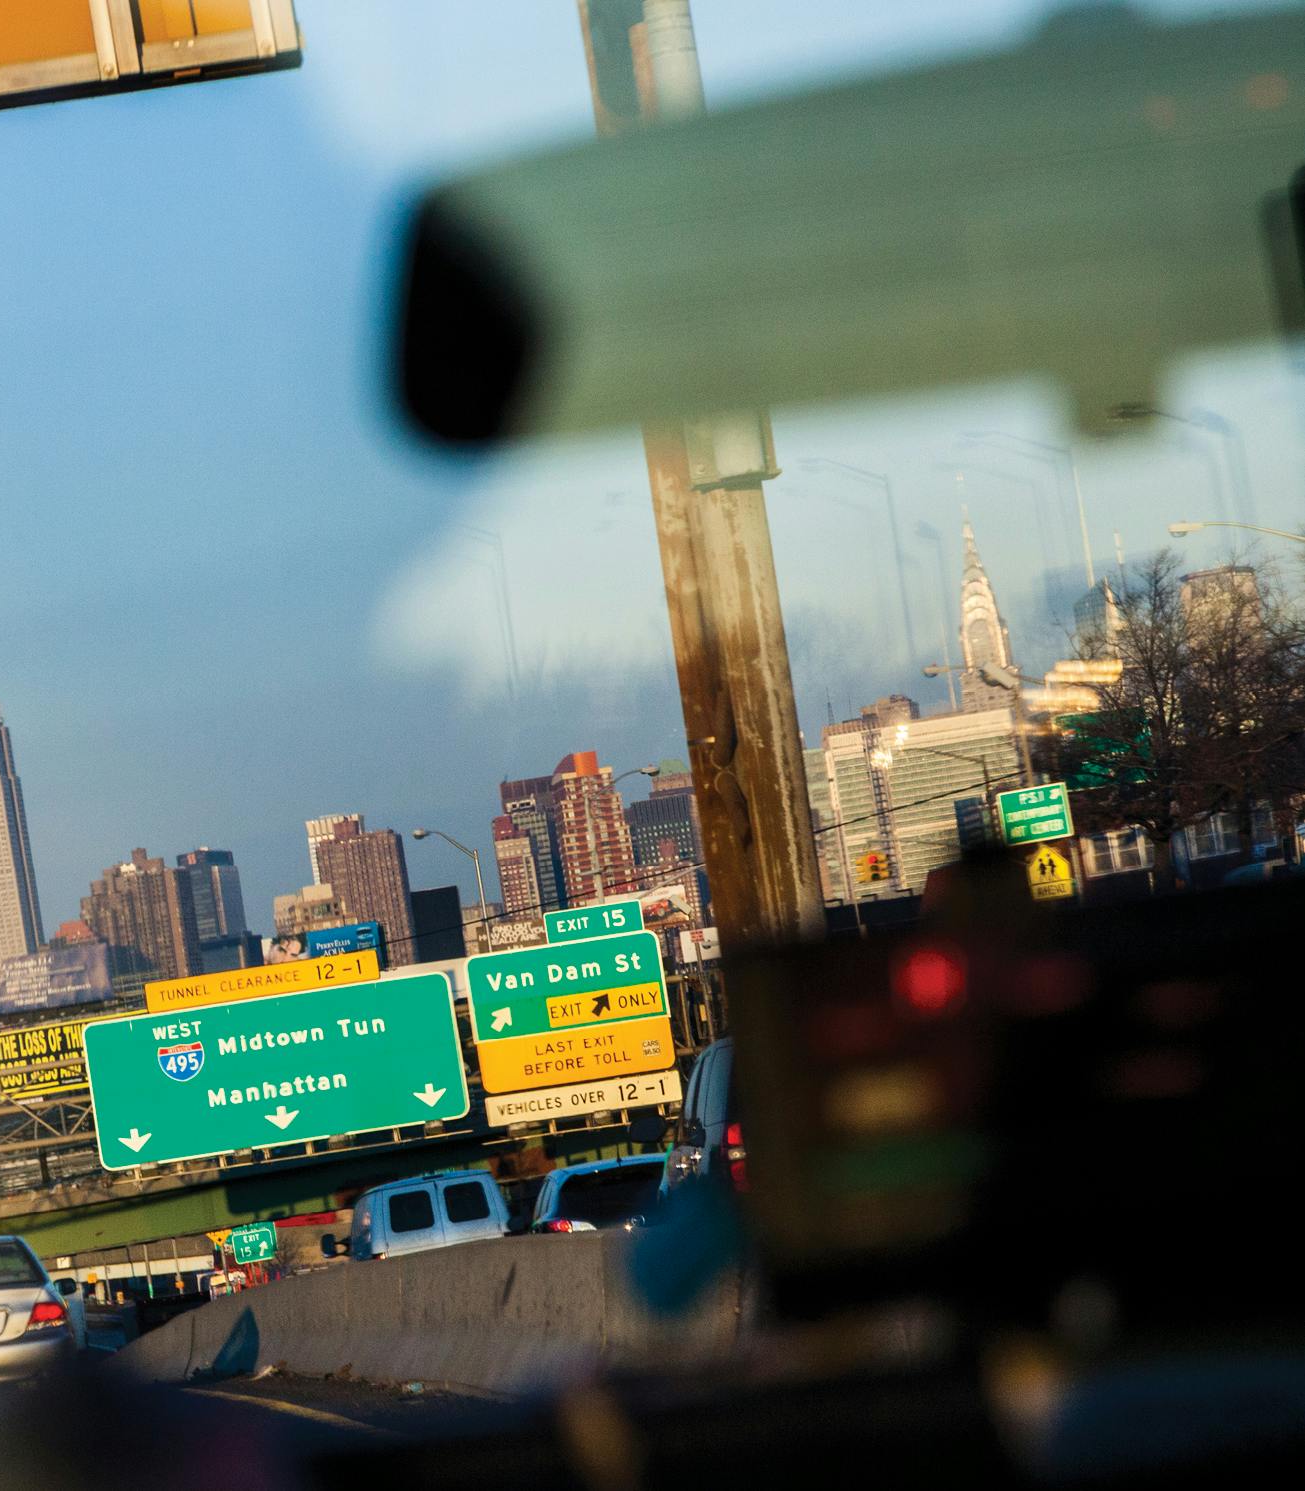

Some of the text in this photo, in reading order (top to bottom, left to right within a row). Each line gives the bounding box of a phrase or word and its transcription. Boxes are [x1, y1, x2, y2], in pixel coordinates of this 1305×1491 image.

[556, 909, 626, 933] EXIT 15
[487, 952, 642, 992] Van Dam St
[160, 984, 210, 1001] TUNNEL
[219, 970, 300, 992] CLEARANCE
[550, 991, 658, 1019] EXIT ONLY
[19, 1030, 47, 1057] LOSS
[48, 1028, 62, 1053] OF
[152, 1021, 202, 1040] WEST
[218, 1017, 386, 1056] Midtown Tun
[534, 1035, 616, 1056] LAST EXIT
[166, 1053, 199, 1073] 495
[524, 1051, 632, 1076] BEFORE TOLL
[207, 1073, 348, 1107] Manhattan
[497, 1097, 563, 1116] VEHICLES
[571, 1090, 606, 1106] OVER
[243, 1233, 260, 1244] EXIT
[240, 1246, 252, 1258] 15
